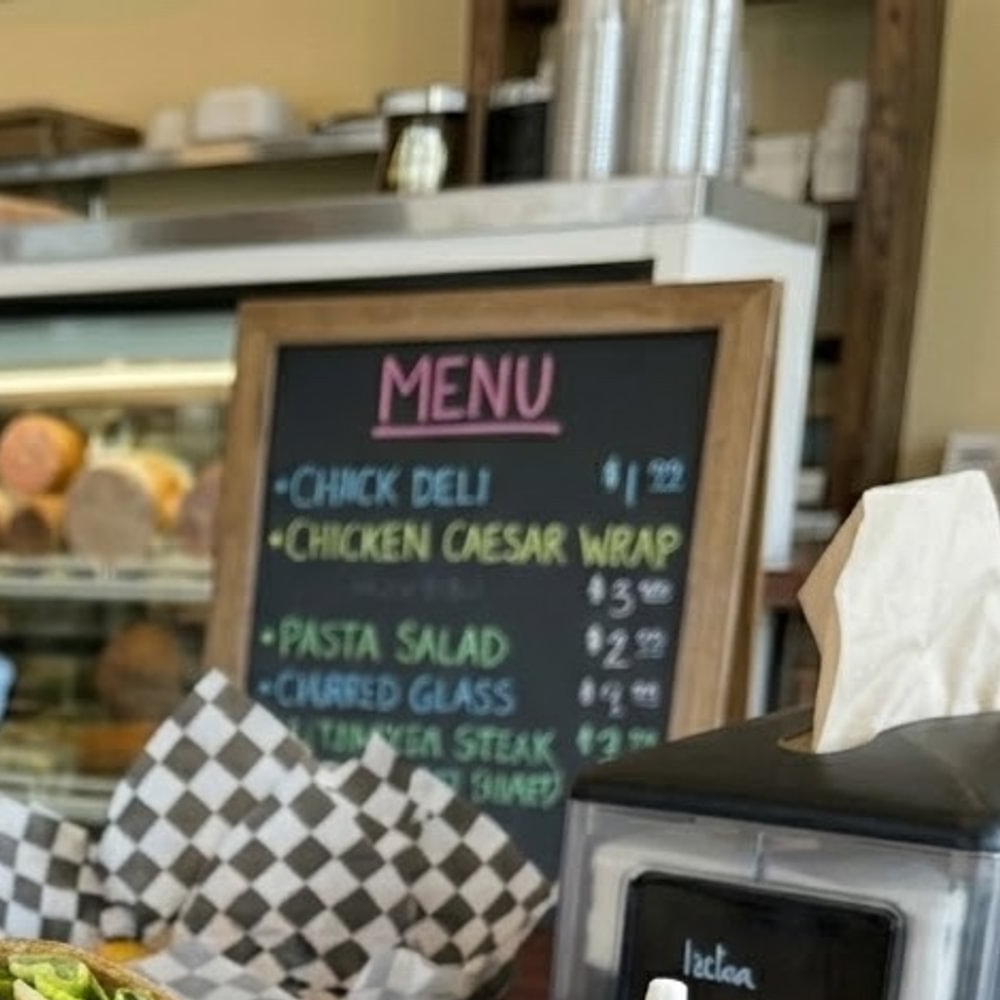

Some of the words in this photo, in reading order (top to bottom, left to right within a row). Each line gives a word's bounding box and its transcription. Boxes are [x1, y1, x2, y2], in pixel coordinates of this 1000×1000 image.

[377, 352, 555, 424] MENU
[411, 464, 492, 510] DELI
[285, 517, 433, 564] CHICKEN
[441, 518, 568, 566] CAESAR
[579, 522, 684, 572] WRAP
[278, 616, 381, 662] PASTA
[395, 620, 510, 669] SALAD
[409, 673, 517, 717] GLASS
[453, 725, 558, 766] STEAK
